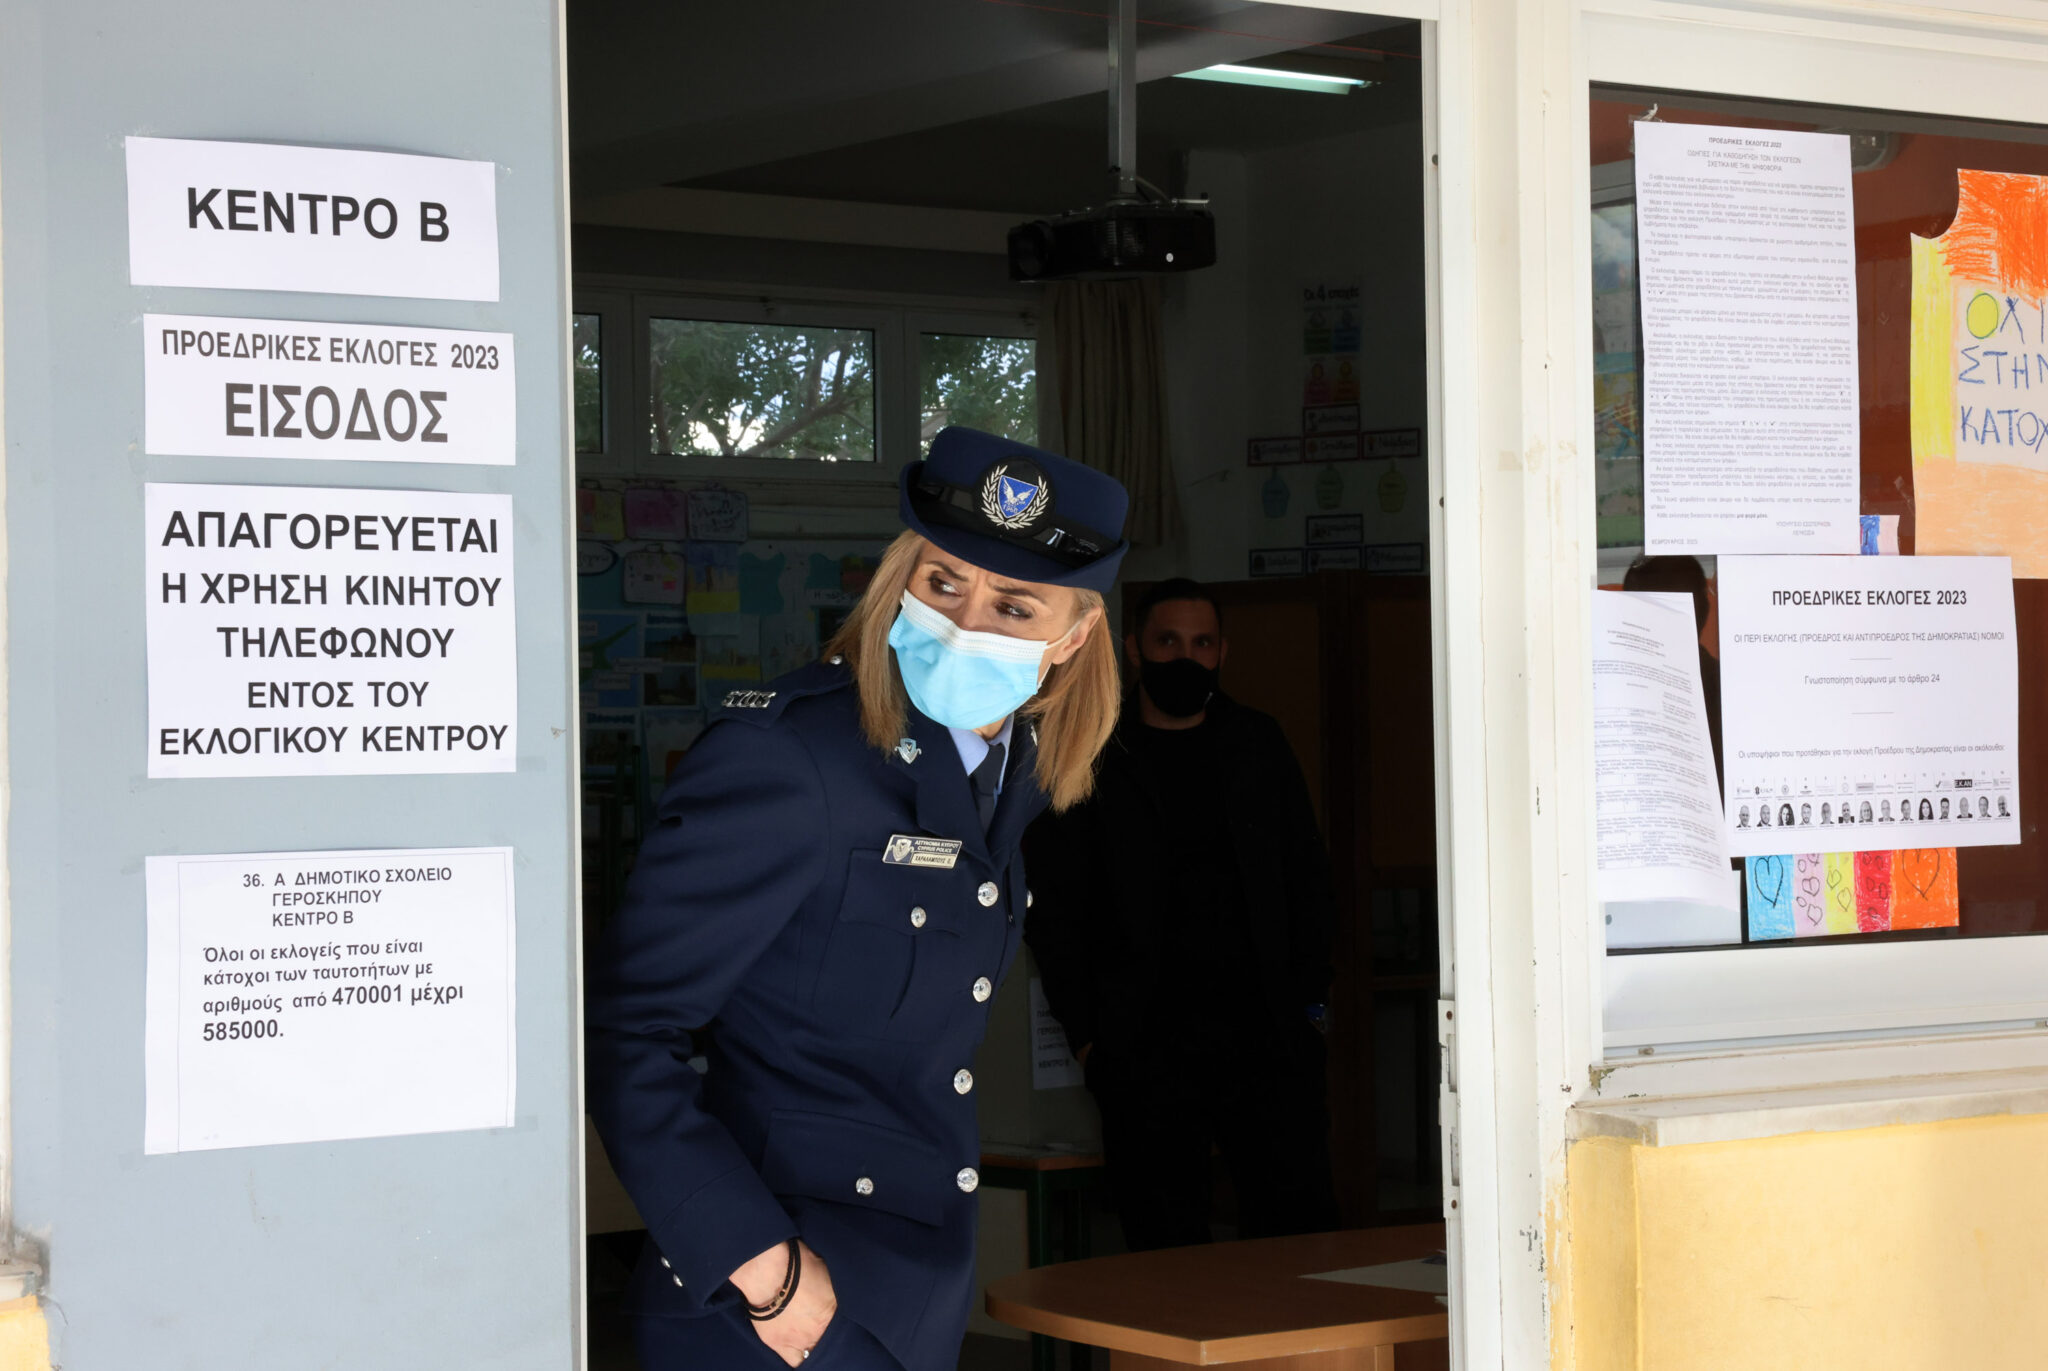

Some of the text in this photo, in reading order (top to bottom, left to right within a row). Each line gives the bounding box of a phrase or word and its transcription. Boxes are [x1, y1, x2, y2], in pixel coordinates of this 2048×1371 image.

[188, 187, 449, 242] ΚΕΝΤΡΟ Β
[163, 329, 499, 370] ΠΡΟΕΔΡΙΚΕΣ ΕΚΛΟΓΕΣ 2023
[226, 383, 448, 443] ΕΙΣΟΔΟΣ
[162, 511, 497, 553] ΑΠΑΓΟΡΕΥΕΤΑΙ
[163, 573, 501, 606] Η ΧΡΗΣΗ ΚΙΝΗΤΟΥ
[1773, 590, 1967, 605] ΠΡΟΕΔΡΙΚΕΣ ΕΚΛΟΓΕΣ 2023
[217, 627, 454, 658] ΤΗΛΕΦΩΝΟΥ
[1734, 635, 1742, 643] ΟΙ
[1743, 634, 1761, 643] ΠΕΡΙ
[1763, 633, 1798, 643] ΕΚΛΟΓΗΣ
[1799, 632, 1841, 643] (ΠΡΟΕΔΡΟΣ
[1855, 632, 1911, 642] ΑΝΤΙΠΡΟΕΔΡΟΣ
[1911, 631, 1927, 641] ΤΗΣ
[1927, 631, 1980, 642] ΔΗΜΟΚΡΑΤΙΑΣ)
[1855, 674, 1887, 685] σύμφωνα
[1907, 673, 1930, 684] άρθρο
[1931, 673, 1941, 683] 24
[248, 681, 429, 708] ΕΝΤΟΣ ΤΟΥ
[161, 725, 508, 755] ΕΚΛΟΓΙΚΟΥ ΚΕΝΤΡΟΥ
[243, 867, 451, 887] 36. Α ΔΗΜΟΤΙΚΟ ΣΧΟΛΕΙΟ
[273, 890, 381, 906] ΓΕΡΟΣΚΗΠΟΥ
[273, 911, 353, 926] ΚΕΝΤΡΟ Β
[203, 939, 422, 962] Όλοι οι εκλογείς που είναι
[204, 962, 432, 987] κάτοχοι των ταυτοτήτων με
[203, 983, 463, 1016] αριθμούς από 470001 μέχρι
[203, 1019, 283, 1041] 585000.
